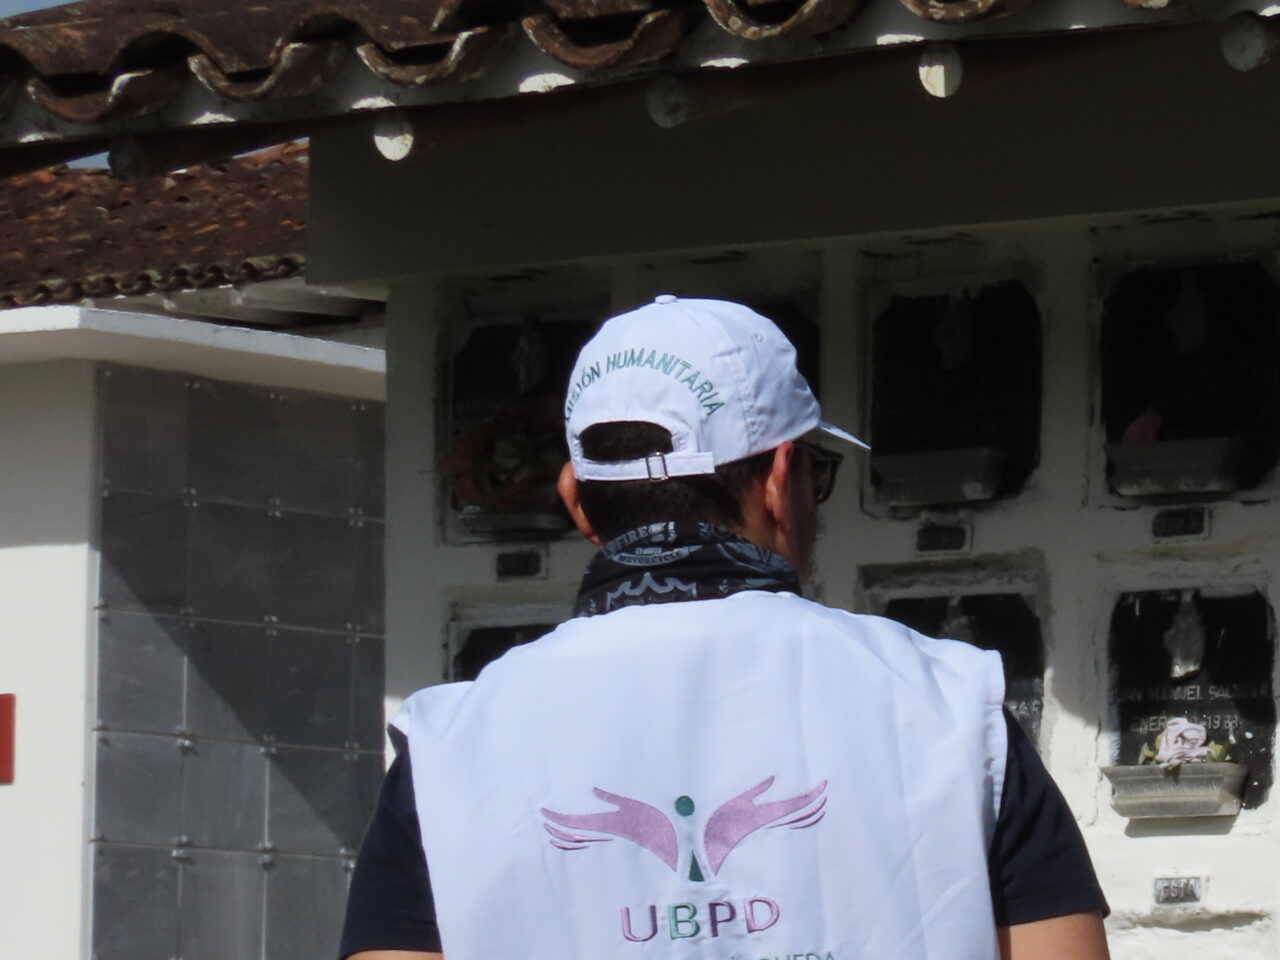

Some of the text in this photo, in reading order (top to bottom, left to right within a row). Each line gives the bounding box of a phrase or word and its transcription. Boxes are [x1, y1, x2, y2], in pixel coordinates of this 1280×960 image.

[606, 347, 726, 416] HUMANITARIA
[1129, 714, 1168, 735] ENER
[620, 896, 781, 943] UBPD
